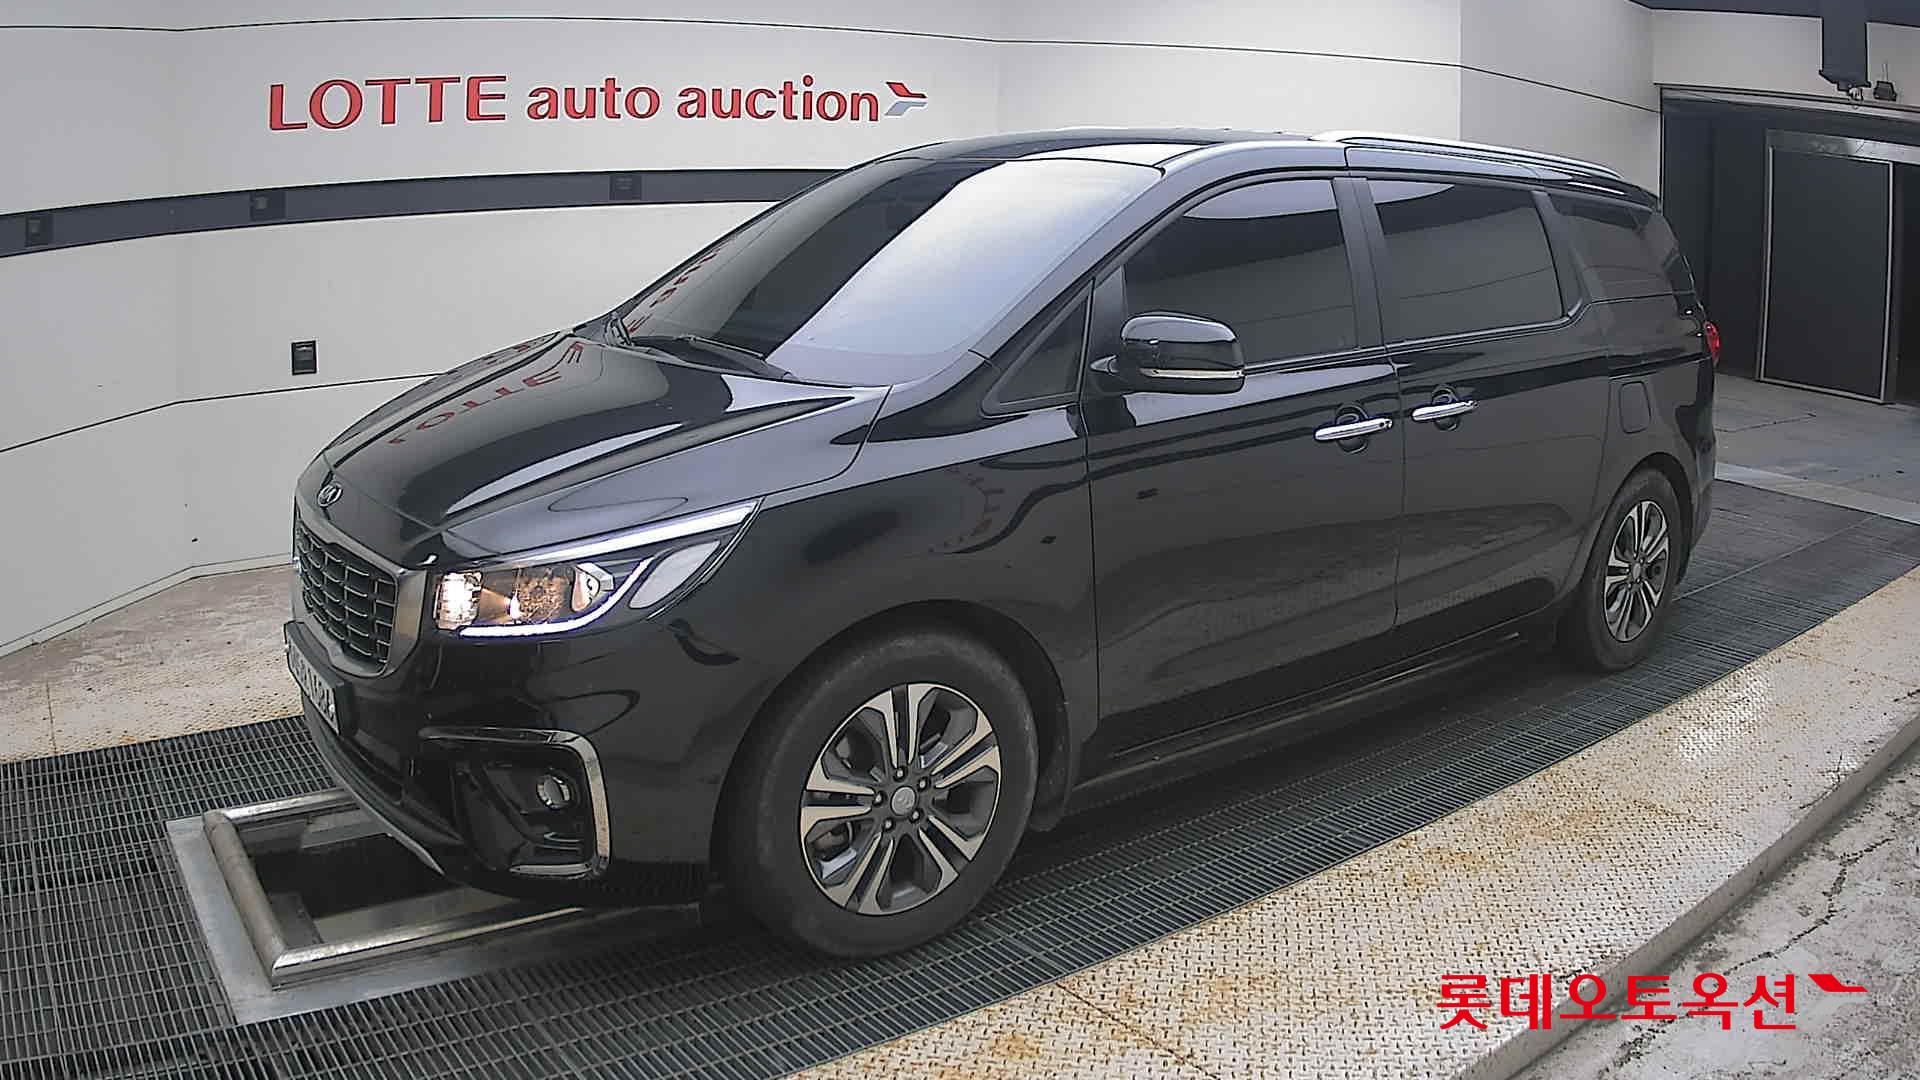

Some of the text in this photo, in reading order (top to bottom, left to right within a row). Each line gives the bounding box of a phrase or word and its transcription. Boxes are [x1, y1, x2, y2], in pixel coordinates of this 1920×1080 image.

[269, 75, 880, 131] LOTTE auto auction
